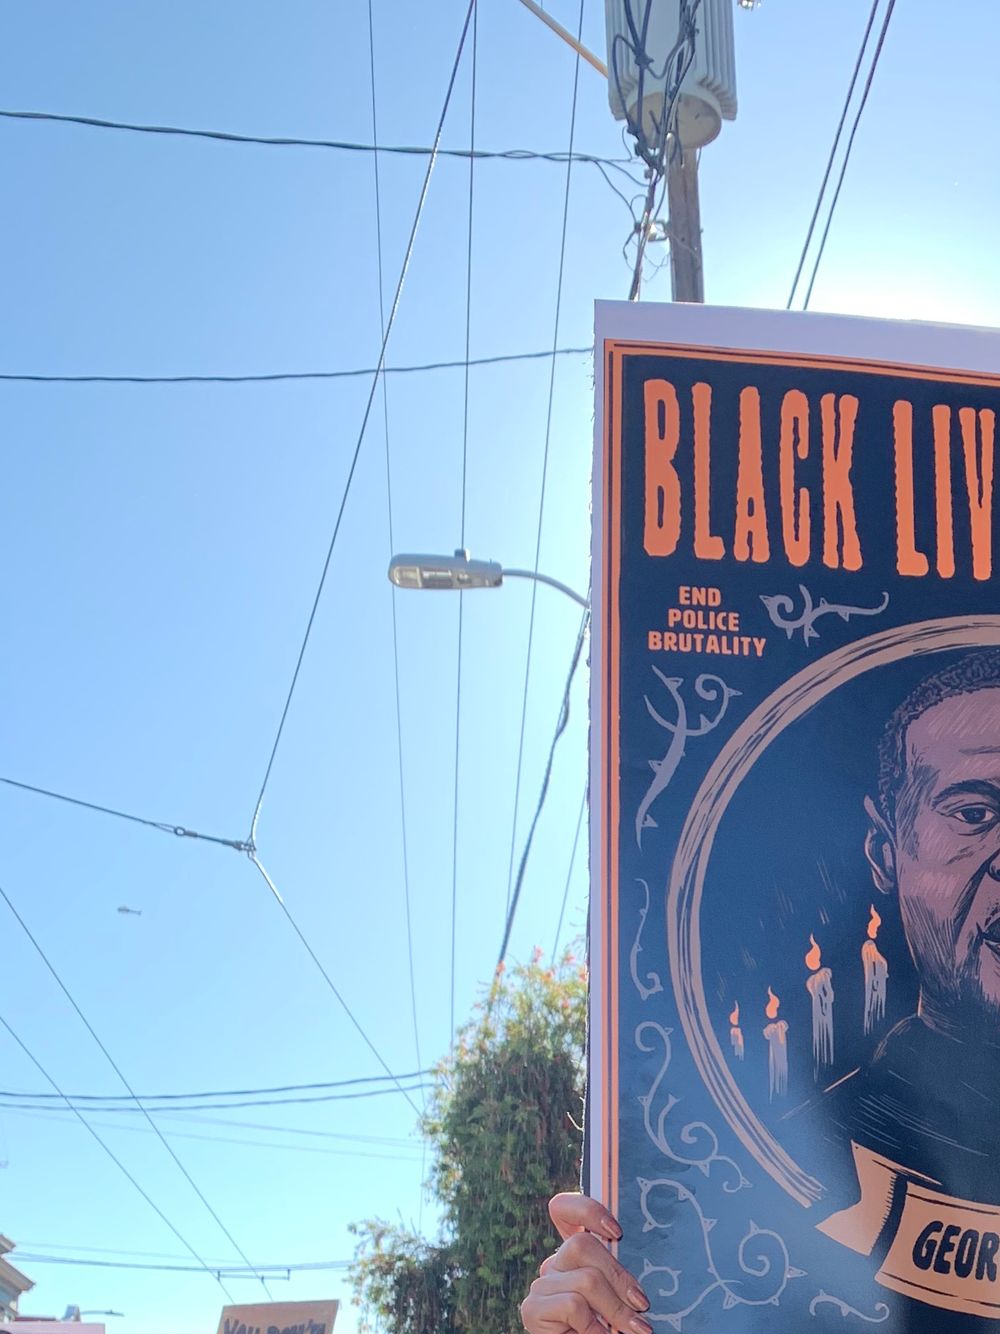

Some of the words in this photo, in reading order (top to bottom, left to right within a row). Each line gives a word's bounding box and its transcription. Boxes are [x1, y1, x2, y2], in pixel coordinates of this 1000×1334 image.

[643, 378, 863, 572] BLACK
[679, 587, 721, 607] END
[668, 608, 739, 632] POLICE
[648, 631, 766, 657] BRUTALITY
